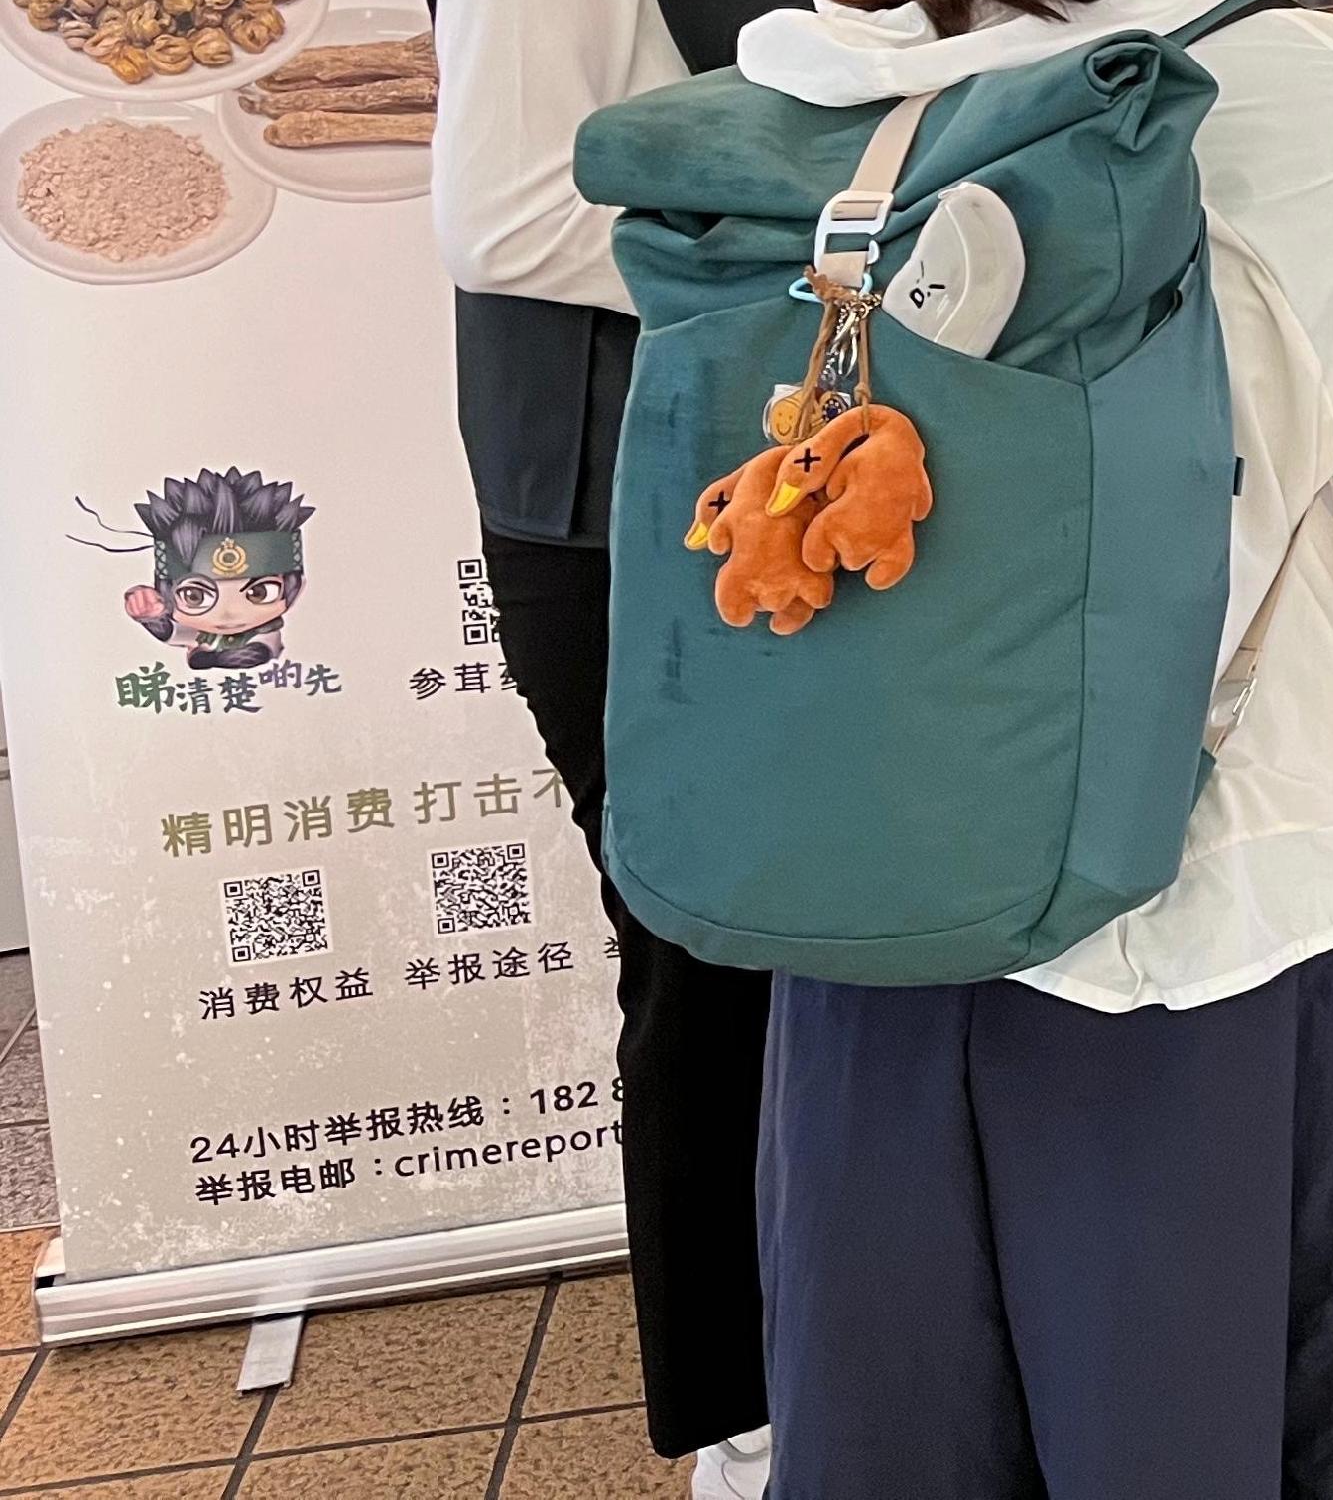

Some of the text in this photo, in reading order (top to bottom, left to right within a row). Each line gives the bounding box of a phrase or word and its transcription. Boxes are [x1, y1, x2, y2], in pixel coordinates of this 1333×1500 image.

[115, 659, 342, 715] 睇清楚啲先
[160, 787, 395, 859] 精明消费
[198, 966, 374, 1021] 消费权益
[404, 940, 574, 991] 举报途径
